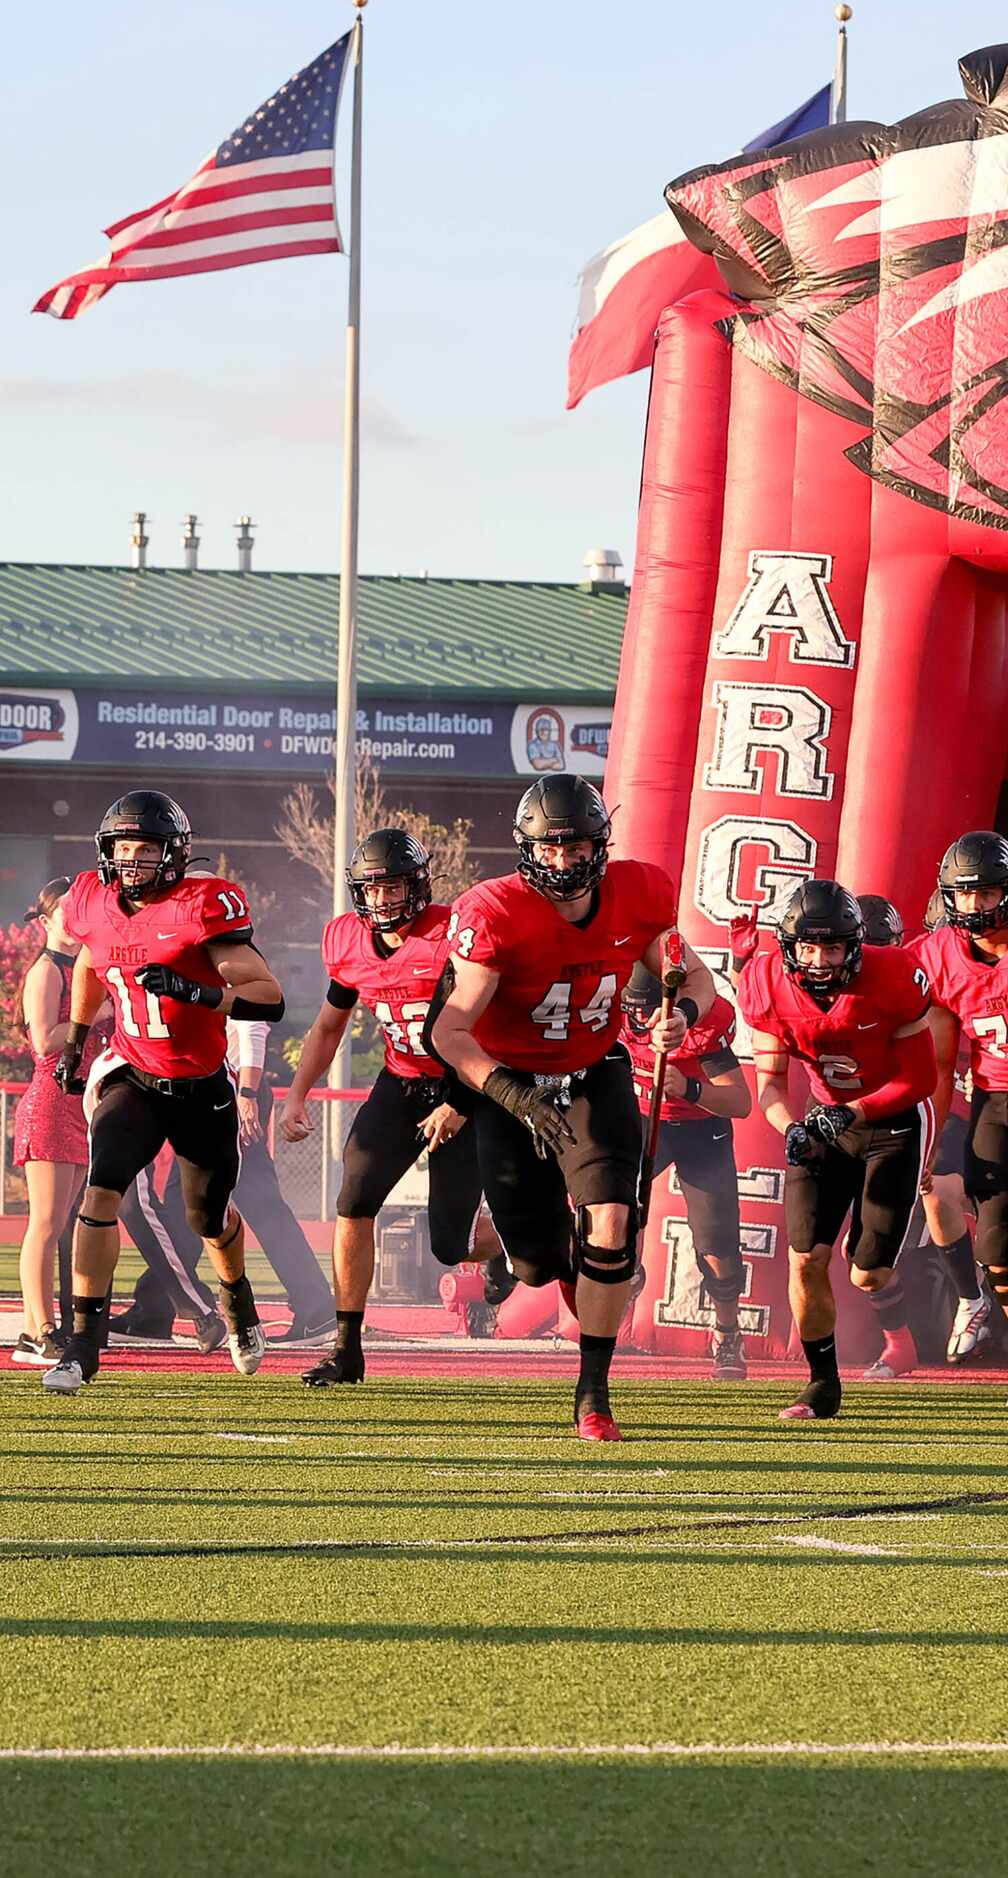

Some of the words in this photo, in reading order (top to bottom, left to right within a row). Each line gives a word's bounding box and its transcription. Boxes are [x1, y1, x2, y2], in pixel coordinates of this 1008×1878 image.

[0, 704, 52, 731] DOOR
[97, 701, 217, 726] Residential
[222, 706, 273, 729] Door
[278, 708, 339, 733] Repai
[375, 711, 494, 735] Installation
[135, 730, 256, 753] 214-390-3901
[280, 735, 456, 760] DFWDorRepair.com
[217, 890, 247, 921] 11
[107, 945, 148, 964] ARGYLE
[105, 965, 171, 1038] 11
[531, 973, 618, 1040] 44
[817, 1054, 864, 1089] 2
